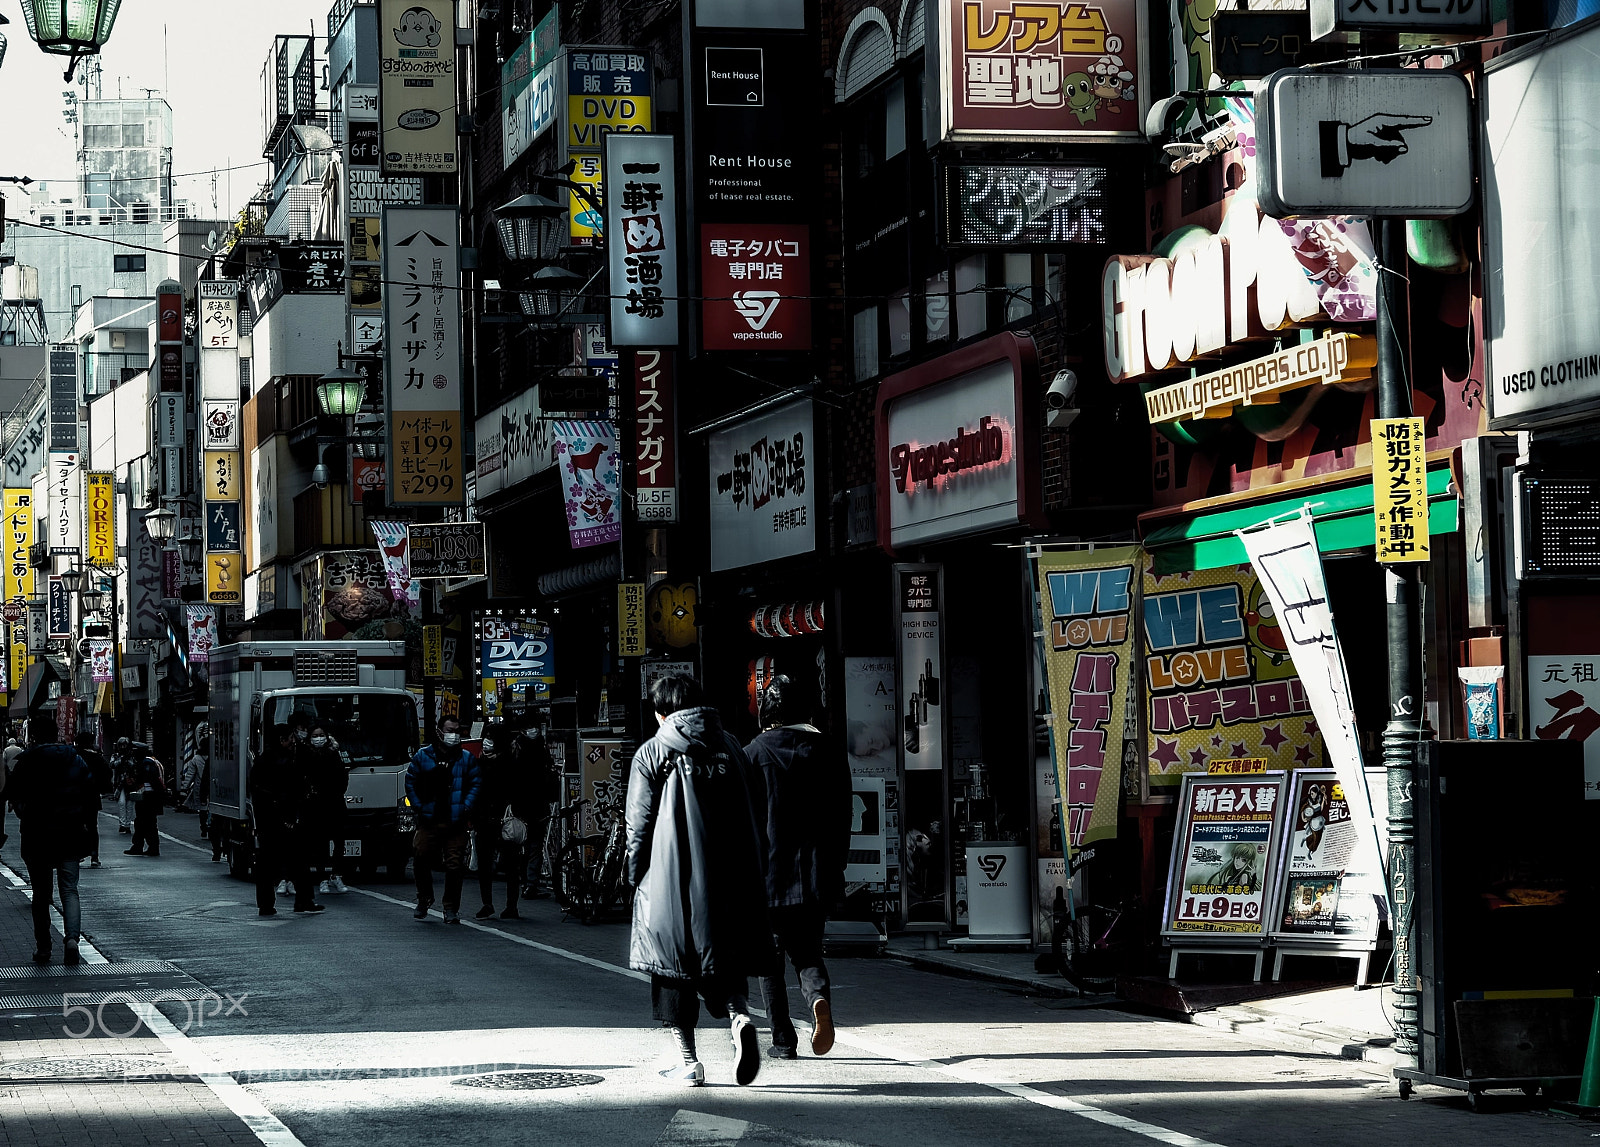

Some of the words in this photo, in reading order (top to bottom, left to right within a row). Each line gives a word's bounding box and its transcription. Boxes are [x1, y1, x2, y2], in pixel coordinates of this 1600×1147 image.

[965, 3, 1122, 54] レア台の
[382, 58, 454, 73] すずめのおやど
[572, 53, 645, 73] 高価買取
[583, 75, 632, 94] 販売
[711, 71, 731, 80] Rent
[733, 71, 759, 80] House
[967, 57, 1061, 104] 聖地
[583, 98, 636, 119] DVD
[405, 152, 442, 162] 吉祥寺店
[709, 154, 742, 168] Rent
[747, 154, 792, 168] House
[350, 184, 421, 200] SOUTHSIDE
[709, 178, 761, 187] Professional
[709, 192, 719, 201] of
[720, 192, 743, 201] lease
[746, 192, 762, 201] real
[765, 192, 794, 201] estate.
[621, 162, 666, 320] 一軒め酒場
[709, 238, 800, 257] 電子タバコ
[728, 262, 783, 280] 専門店
[202, 284, 235, 296] 中外ビル
[431, 257, 446, 361] 旨唐揚げと居酒メシ
[401, 257, 427, 390] ミライザカ
[211, 336, 230, 346] 5F
[1147, 331, 1345, 419] www.greenpeas.co.jp
[1502, 370, 1536, 396] USED
[1540, 353, 1600, 388] CLOTHIN
[400, 417, 453, 433] ハイボール
[400, 458, 453, 474] 生ビール
[717, 431, 806, 512] 一軒め酒場
[1412, 422, 1423, 518] 安全安心まちづくり
[89, 476, 110, 485] 麻雀
[1385, 423, 1415, 557] 防犯カメラ作動中
[651, 490, 671, 502] 5F
[92, 486, 109, 557] FOREST
[213, 505, 239, 544] 大戸屋
[410, 525, 481, 537] 全身もみほぐし
[911, 576, 928, 586] 電子
[211, 592, 238, 600] GOOSE
[907, 588, 932, 597] タバコ
[1046, 566, 1132, 617] WE
[907, 598, 932, 608] 専門店
[625, 586, 638, 654] 防犯カメラ作動中
[1142, 585, 1246, 651] WE
[485, 620, 504, 639] 3F
[1051, 614, 1129, 649] LOVE
[489, 641, 548, 660] DVD
[1146, 644, 1251, 691] LOVE
[1542, 662, 1599, 684] 元祖
[1209, 758, 1267, 773] 2Fで稼働中!
[1194, 787, 1277, 813] 新台入替
